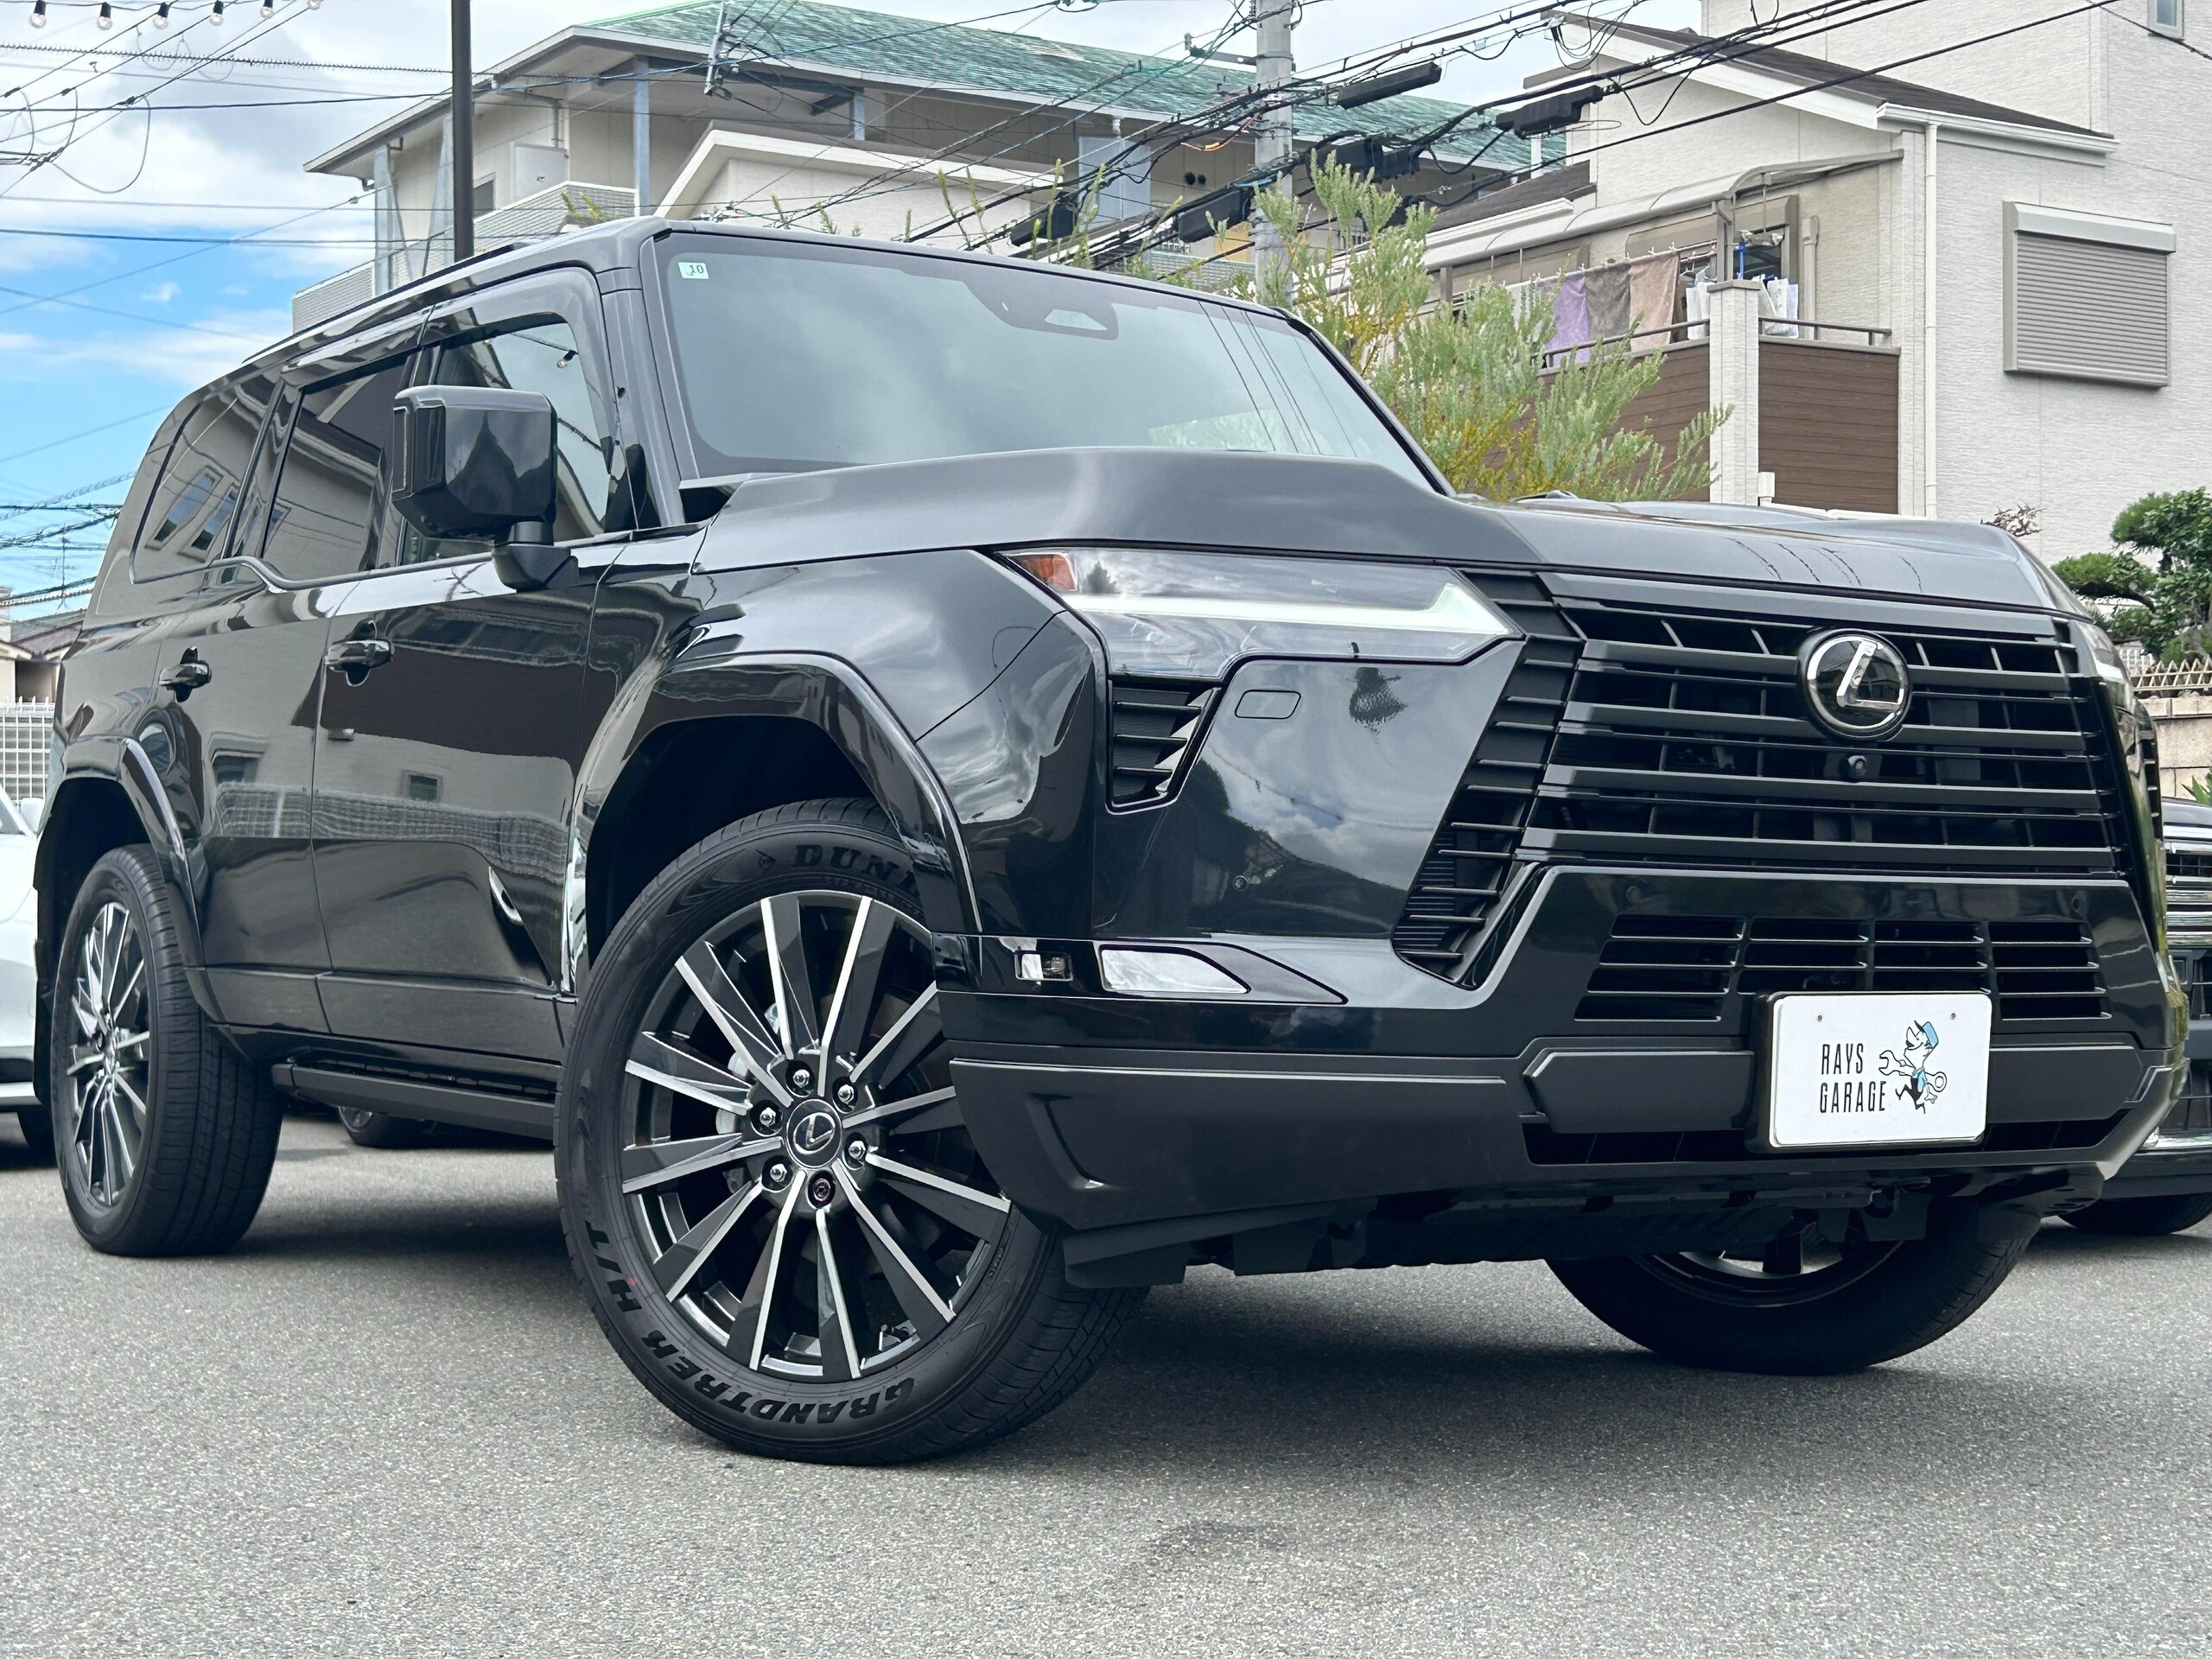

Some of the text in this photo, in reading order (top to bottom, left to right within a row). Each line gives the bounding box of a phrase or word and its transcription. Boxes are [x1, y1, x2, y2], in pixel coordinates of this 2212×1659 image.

[690, 264, 704, 274] 10
[1821, 1043, 1864, 1075] RAYS
[1820, 1080, 1886, 1113] GARAGE
[584, 1220, 915, 1424] GRANDTREK H/T
